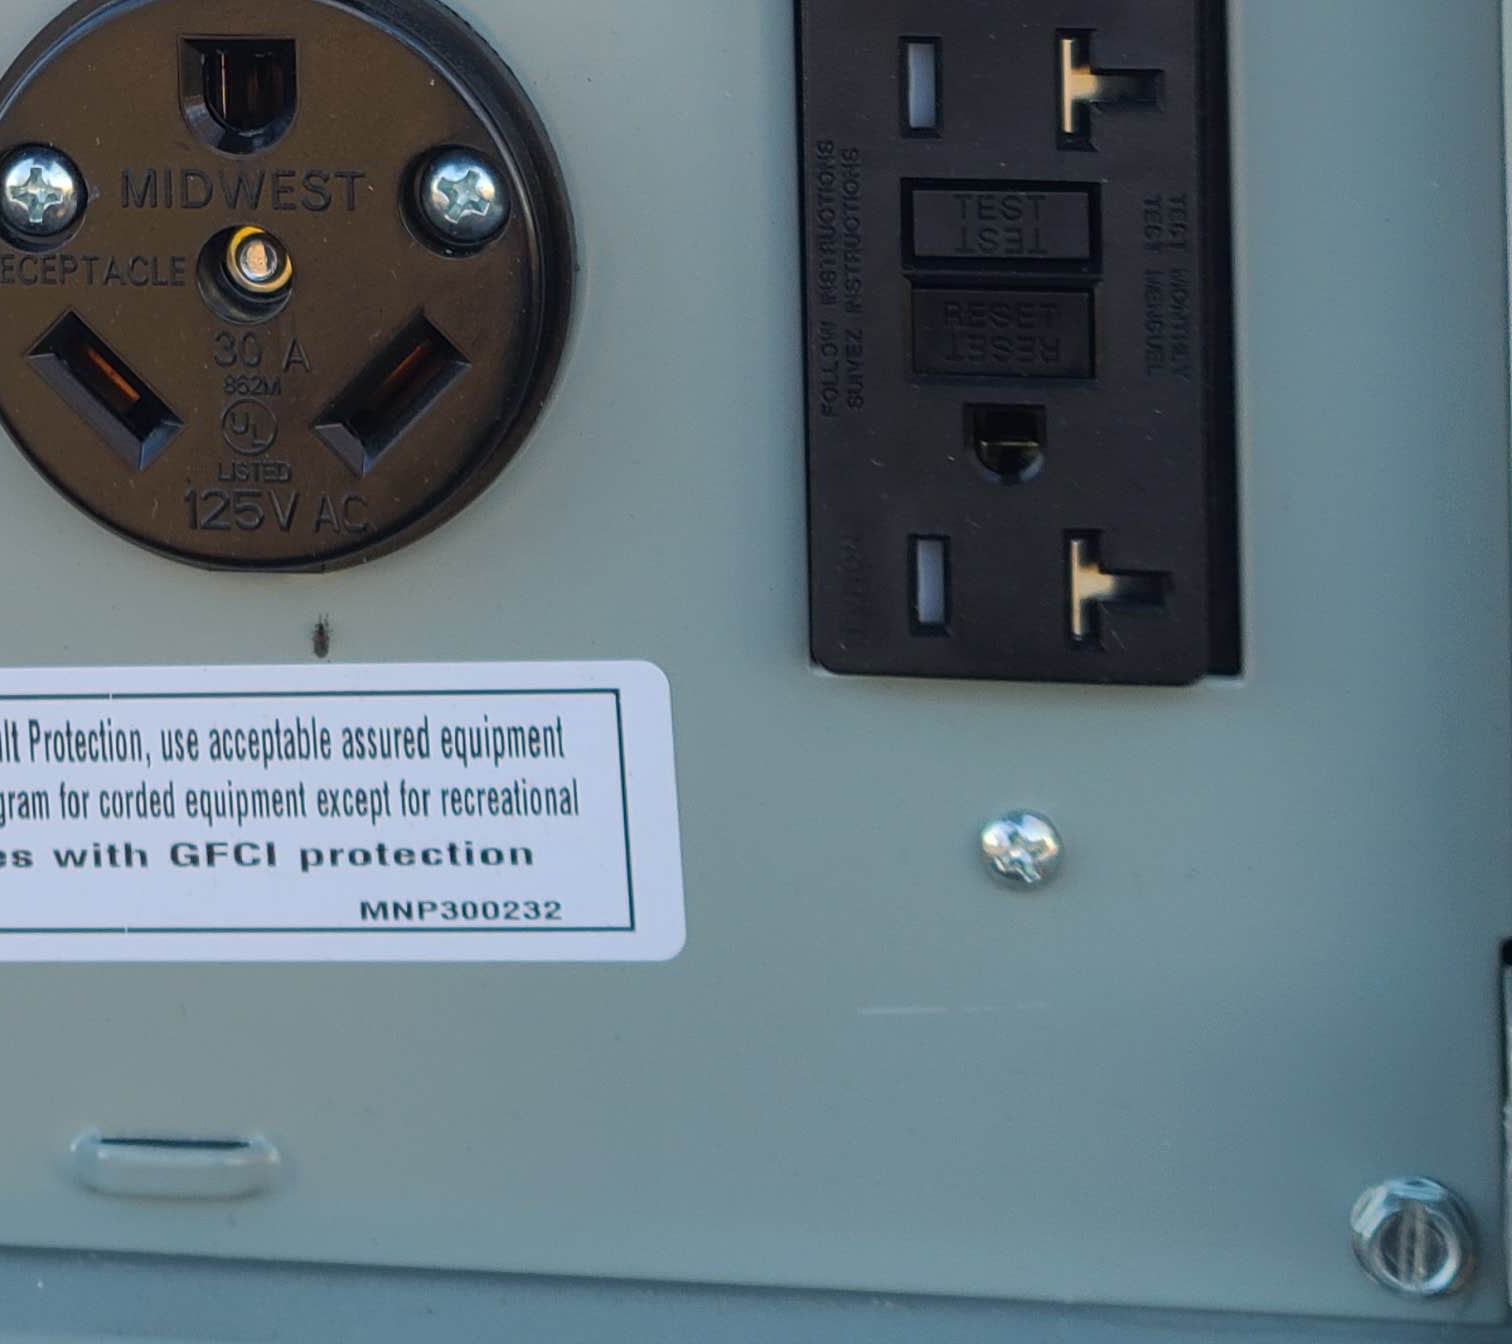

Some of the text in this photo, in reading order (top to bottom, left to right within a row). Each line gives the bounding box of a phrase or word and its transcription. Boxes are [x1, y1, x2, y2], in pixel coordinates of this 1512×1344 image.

[119, 167, 368, 214] MIDWEST
[952, 193, 1047, 221] TEST
[953, 226, 1049, 255] TEST
[943, 300, 1060, 329] RESET
[213, 331, 312, 373] 30 A
[217, 461, 293, 484] LISTED
[183, 489, 370, 535] 125V AC
[28, 717, 151, 767] Protection,
[160, 729, 200, 762] use
[209, 716, 332, 769] acceptable
[341, 715, 431, 760] assured
[440, 714, 565, 768] equipment
[360, 901, 561, 921] MNP300232
